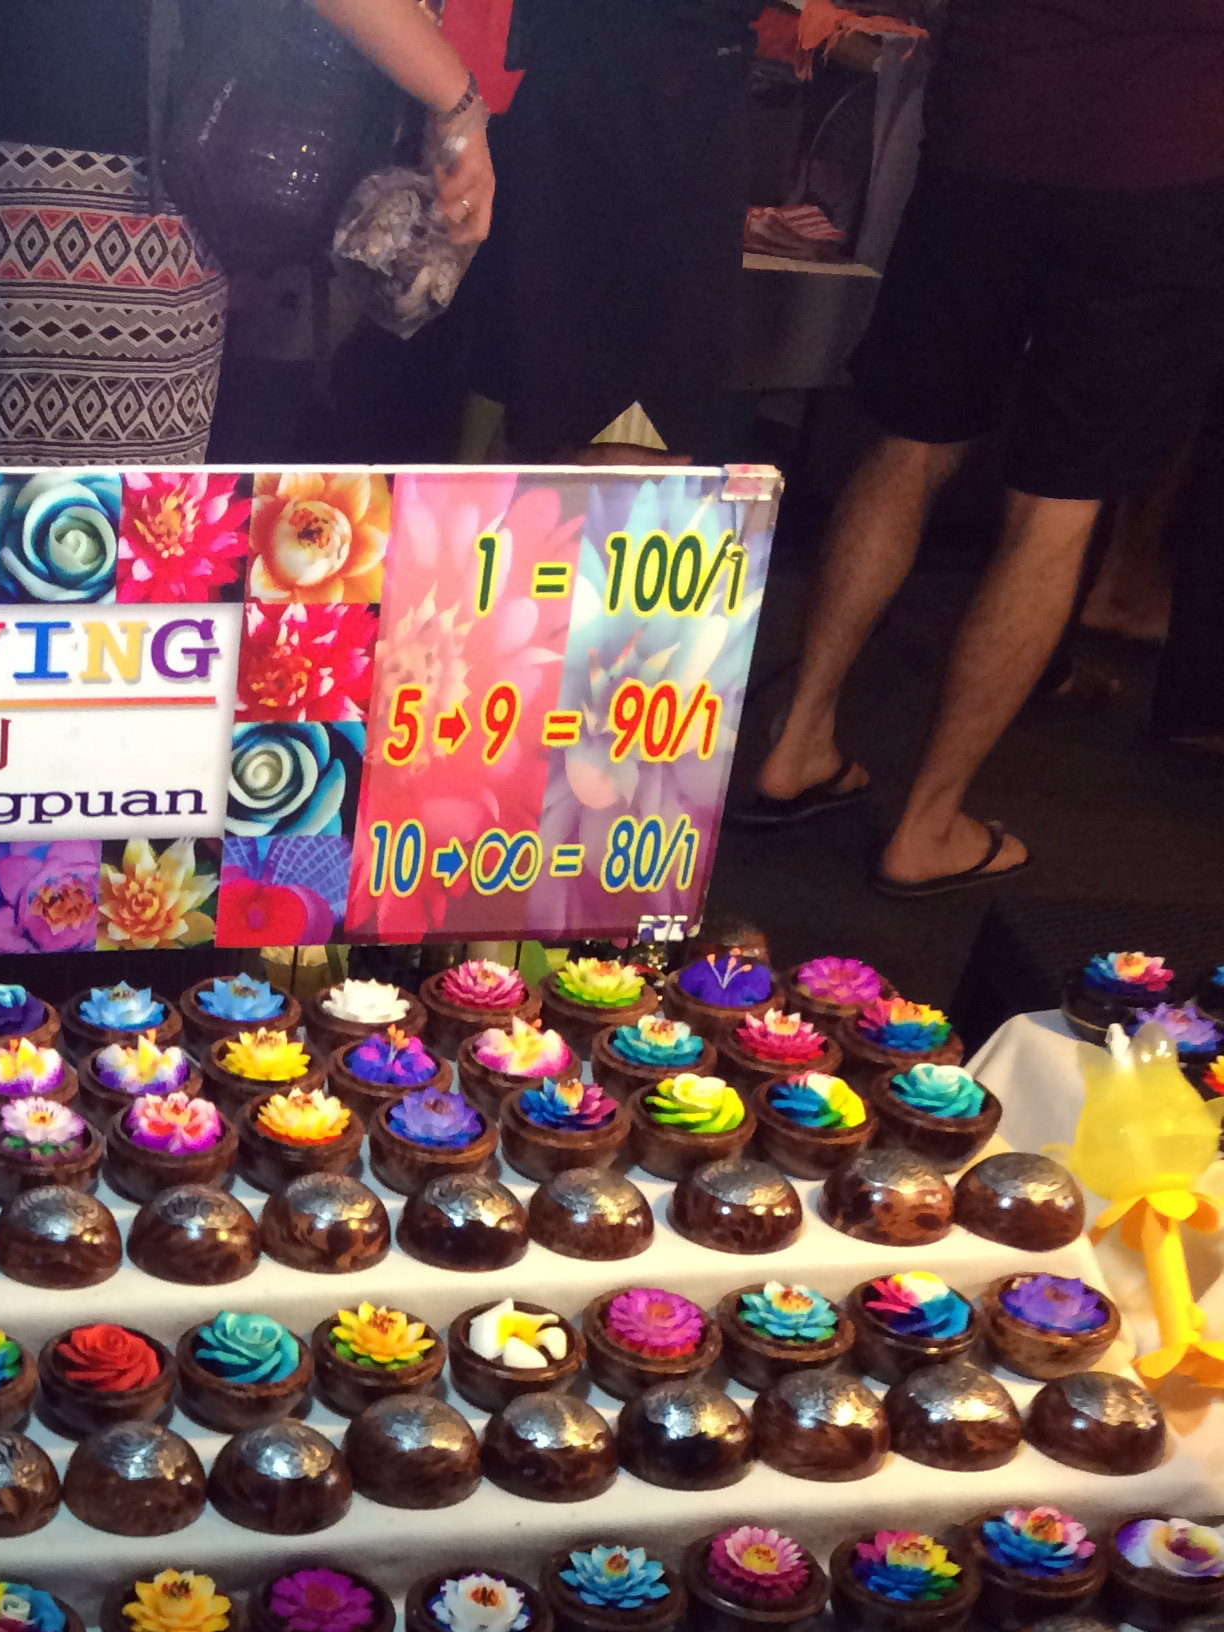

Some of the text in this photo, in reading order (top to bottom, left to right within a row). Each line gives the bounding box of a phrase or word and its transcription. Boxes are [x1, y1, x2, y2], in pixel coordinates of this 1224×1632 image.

[476, 534, 498, 614] 1
[607, 532, 746, 615] 100/1
[384, 685, 422, 763] 5
[482, 682, 518, 763] 9
[611, 681, 721, 762] 90/1
[370, 819, 425, 896] 10
[601, 814, 698, 891] 80/1
